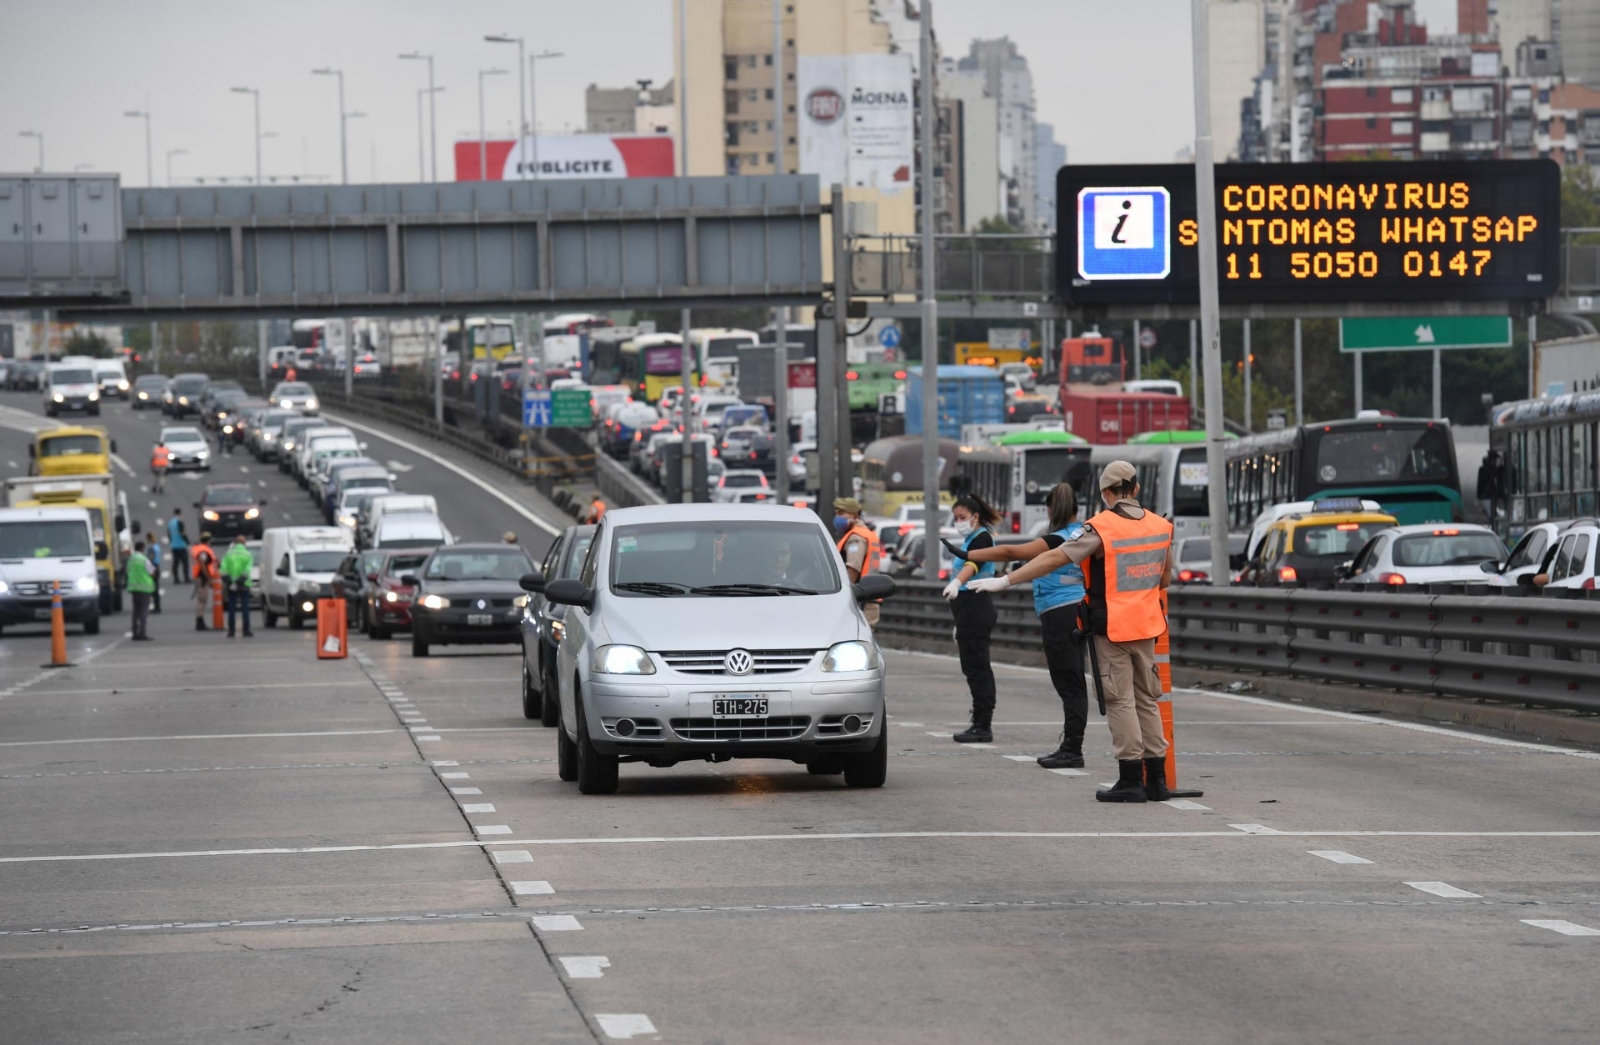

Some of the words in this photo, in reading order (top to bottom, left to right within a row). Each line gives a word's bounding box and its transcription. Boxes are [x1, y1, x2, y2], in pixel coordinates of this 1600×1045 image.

[1223, 182, 1469, 212] CORONAVIRUS
[1178, 217, 1356, 246] SNTOMAS
[1381, 215, 1538, 244] WHATSAP
[1226, 252, 1262, 279] 11
[1290, 251, 1378, 279] 5050
[1403, 250, 1492, 277] 0147
[714, 700, 737, 714] ETH
[744, 699, 767, 714] 275
